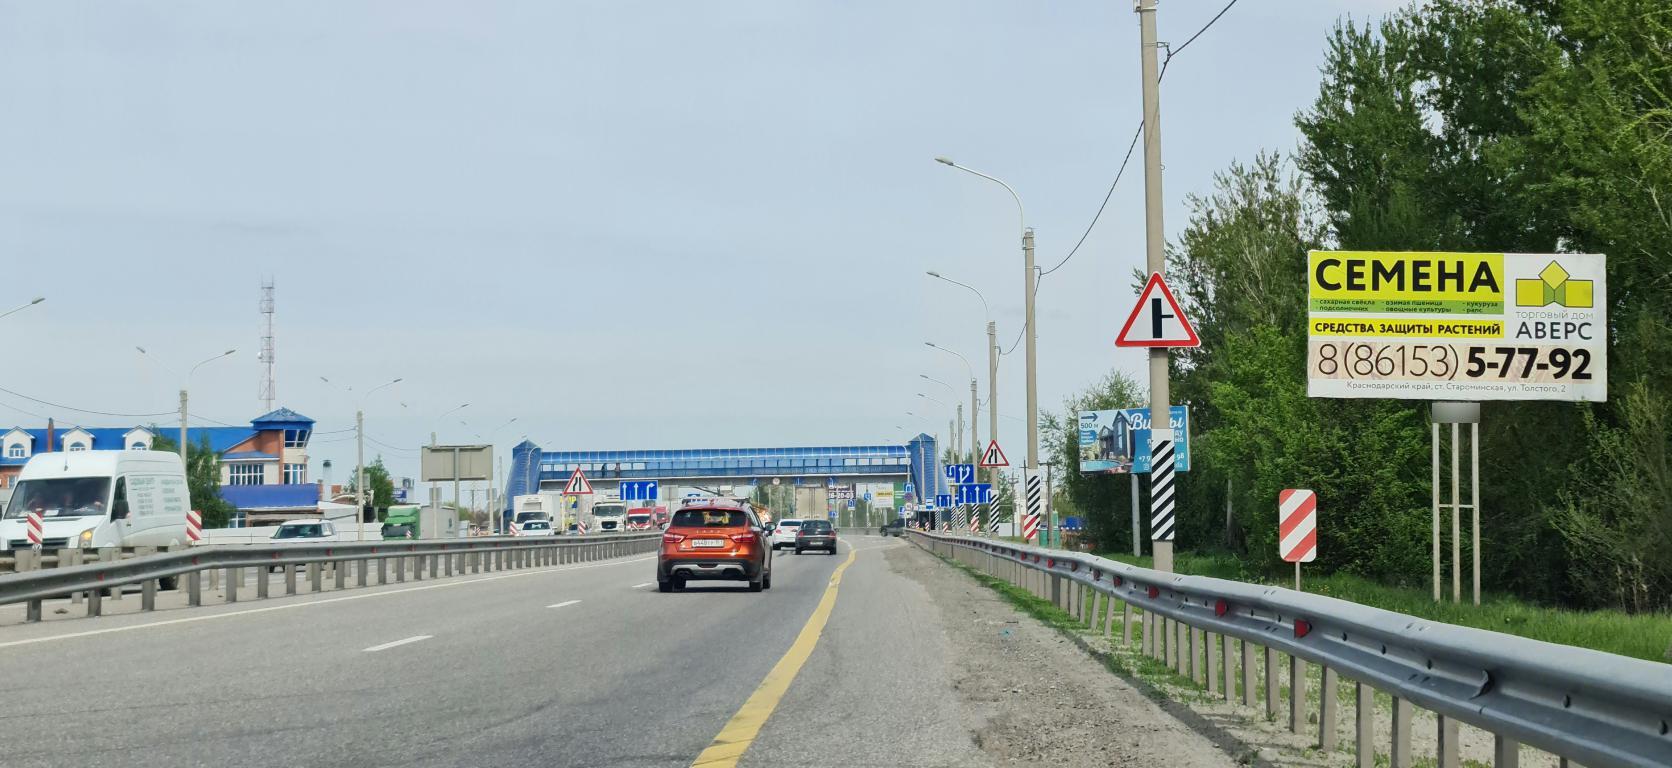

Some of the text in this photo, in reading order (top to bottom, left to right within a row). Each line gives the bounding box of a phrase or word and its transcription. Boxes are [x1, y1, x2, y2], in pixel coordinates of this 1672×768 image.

[1315, 258, 1501, 293] СЕМЕНА
[1516, 310, 1594, 320] торговый дом
[1315, 322, 1501, 335] СРЕДСТВА ЗАЩИТЫ РАСТЕНИЙ
[1515, 321, 1593, 340] АВЕРС
[1466, 346, 1592, 380] 5-77-92
[1346, 382, 1410, 390] Краснодарский
[1411, 383, 1433, 391] край,
[1561, 385, 1566, 393] 2
